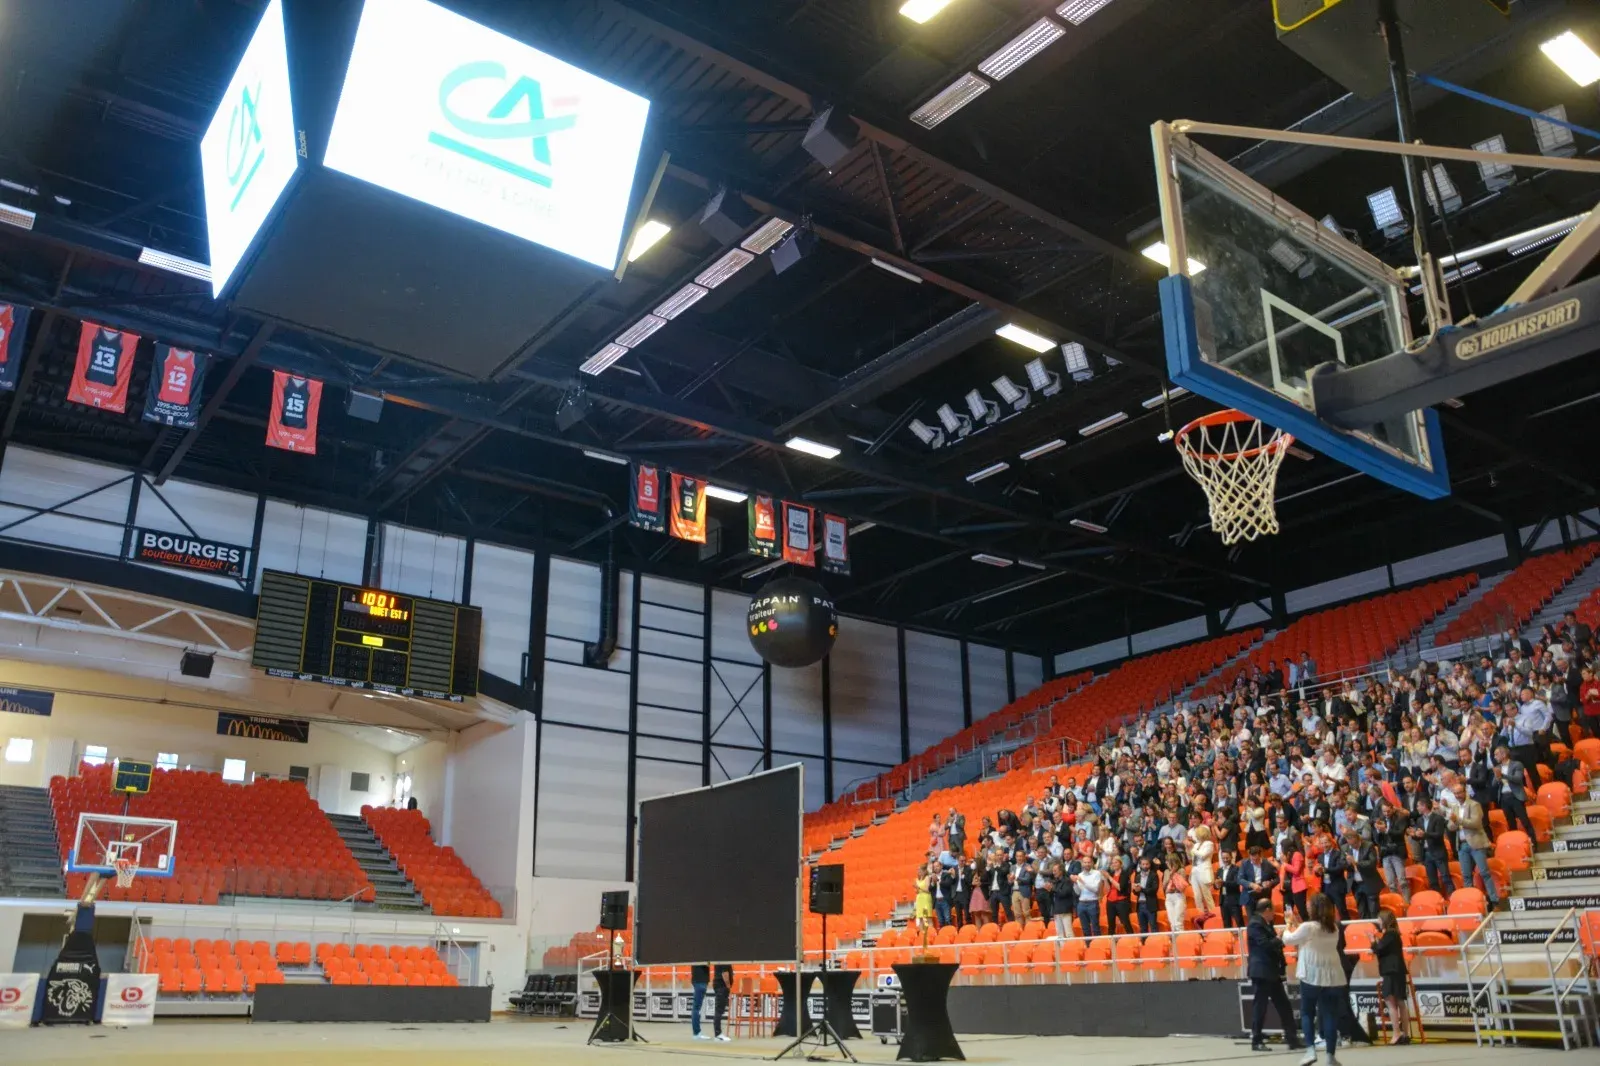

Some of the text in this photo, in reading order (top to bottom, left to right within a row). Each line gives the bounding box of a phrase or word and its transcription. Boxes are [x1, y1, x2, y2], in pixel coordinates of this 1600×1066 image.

[297, 130, 308, 159] Bodet
[1481, 302, 1576, 350] NOUANSPORT
[94, 351, 115, 367] 13
[168, 371, 187, 386] 12
[286, 397, 304, 412] 15
[644, 485, 653, 496] 9
[759, 513, 771, 525] 14
[143, 533, 240, 563] BOURGES
[142, 548, 183, 562] soutient
[184, 554, 223, 570] l'exploit
[749, 608, 777, 622] traiteur
[249, 716, 280, 725] TRIBUNE
[1569, 841, 1592, 851] Région
[1549, 869, 1572, 879] Région
[1527, 900, 1551, 910] Région
[1551, 898, 1584, 907] Centre-Val
[1586, 897, 1595, 905] de
[1503, 933, 1528, 942] Région
[1564, 931, 1573, 939] de
[110, 1003, 150, 1011] boulanger
[1446, 1005, 1458, 1014] Val
[1459, 1005, 1468, 1014] de
